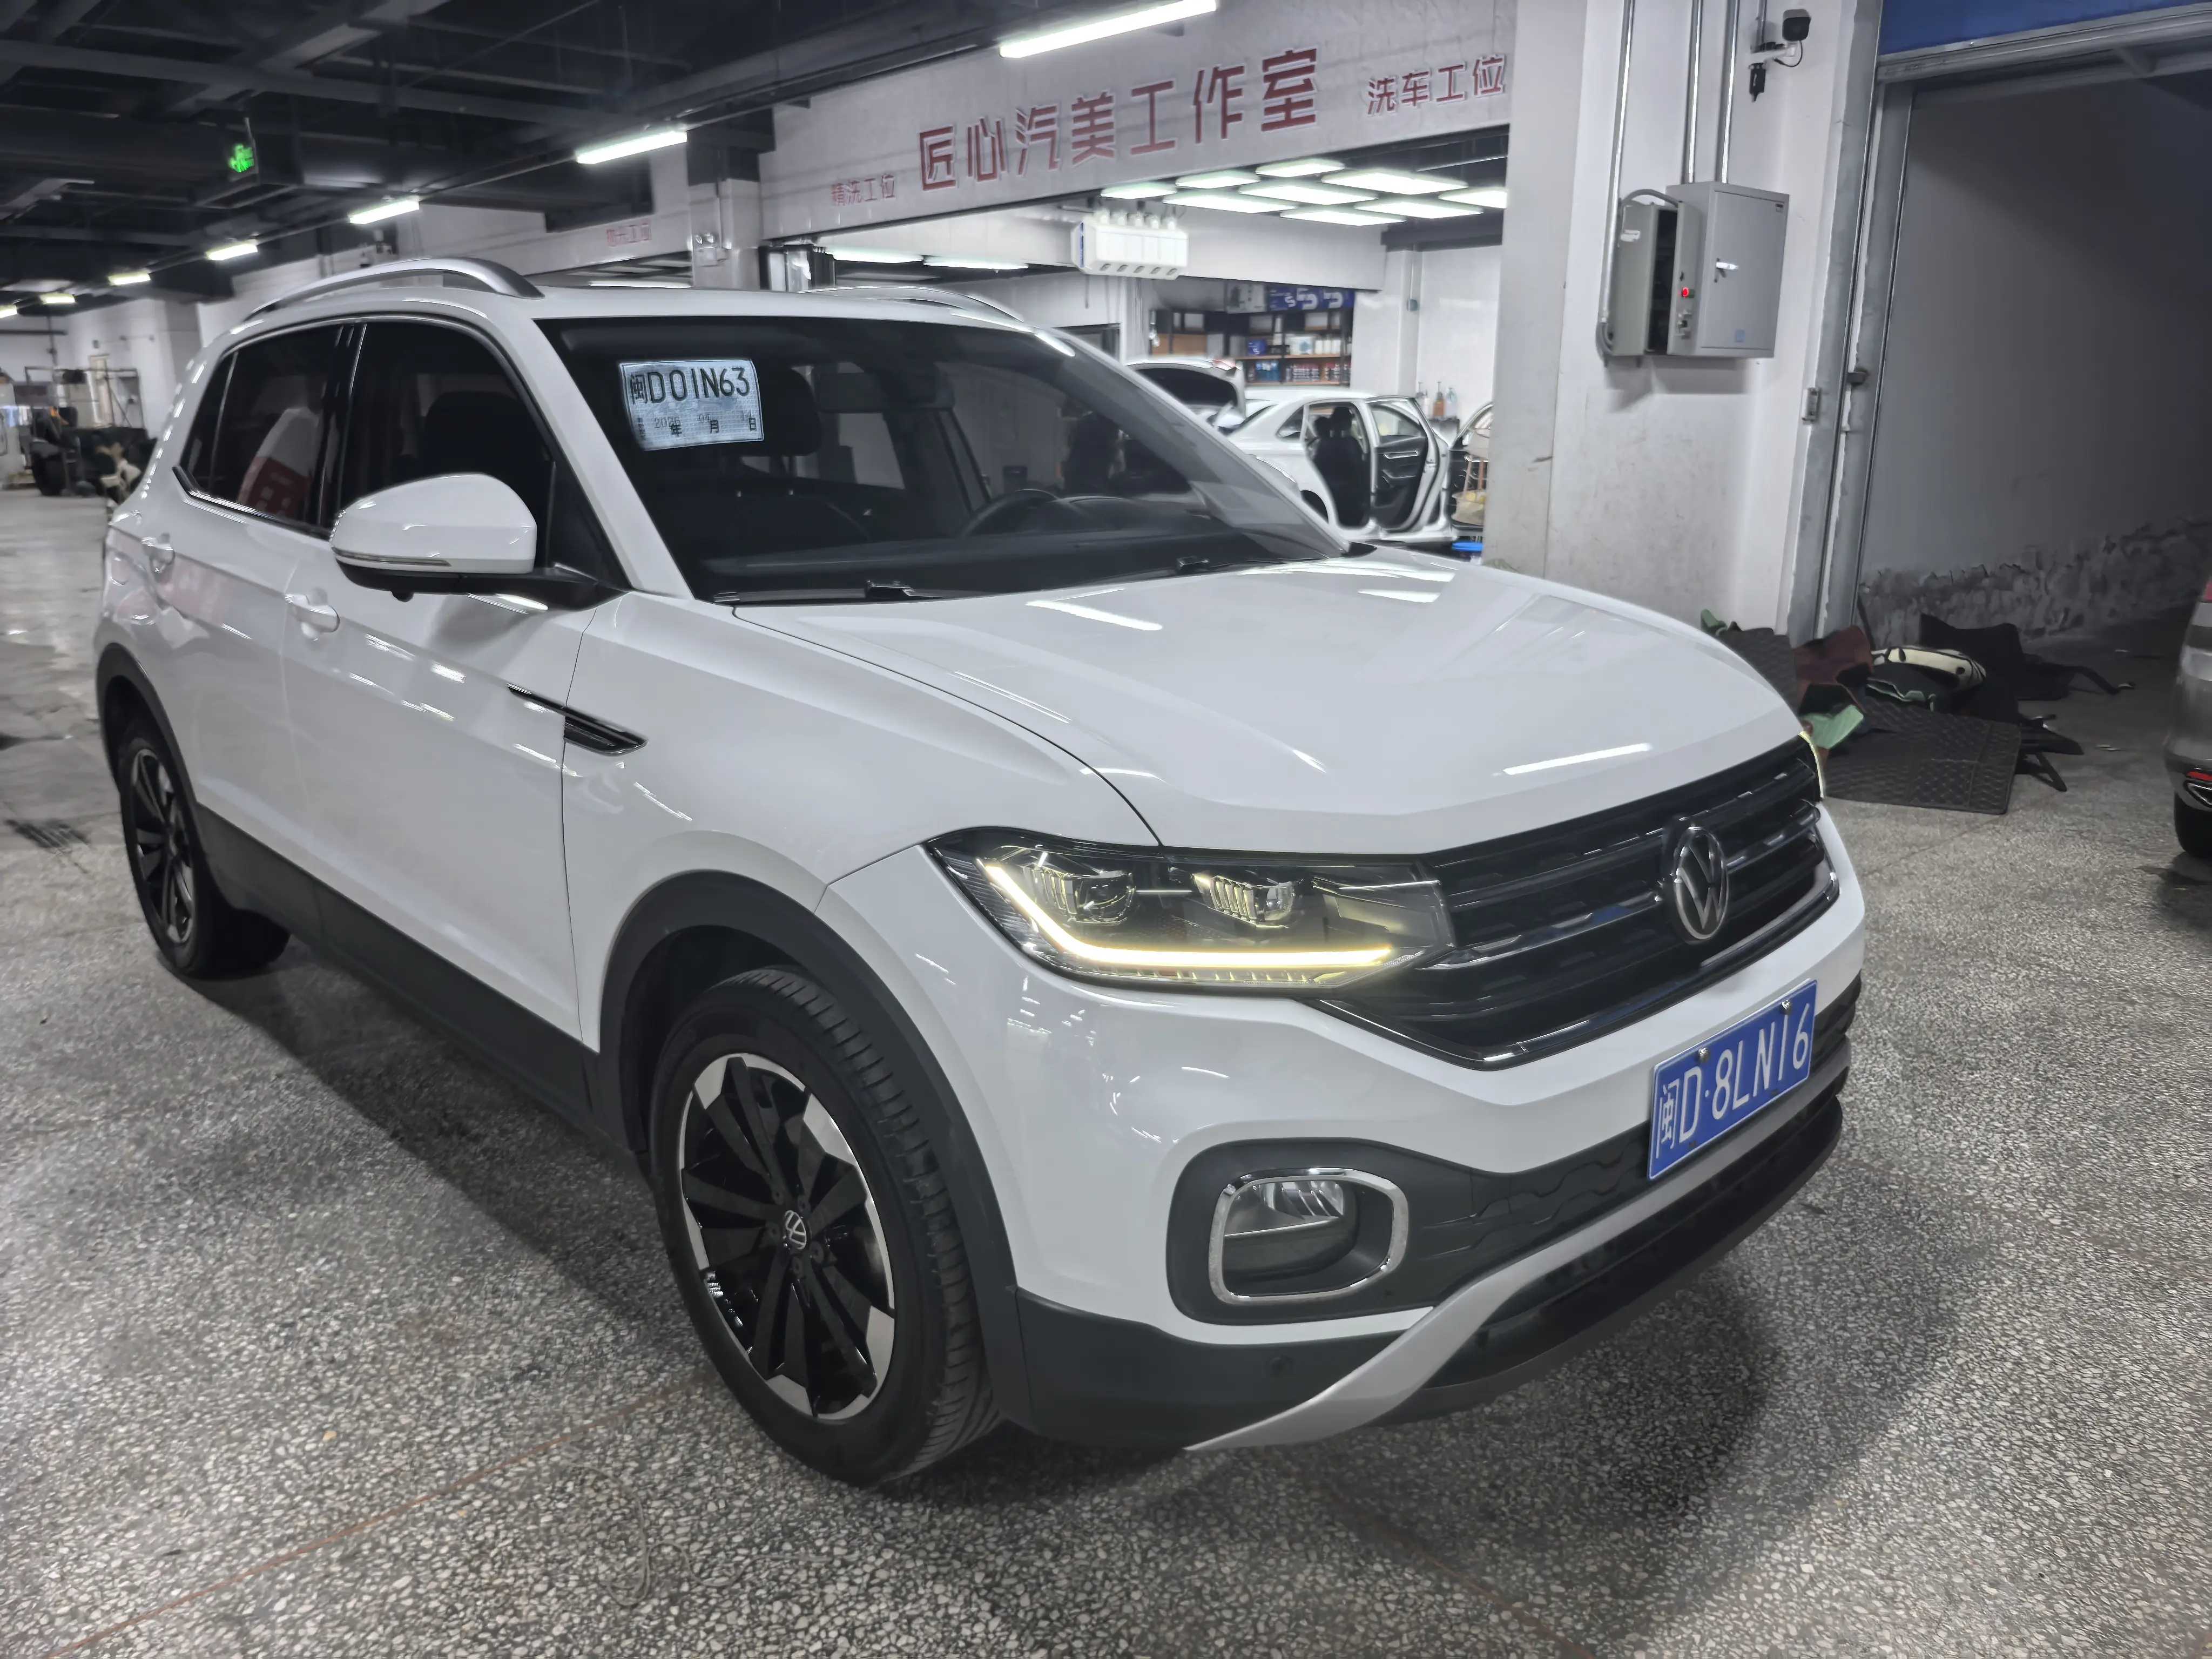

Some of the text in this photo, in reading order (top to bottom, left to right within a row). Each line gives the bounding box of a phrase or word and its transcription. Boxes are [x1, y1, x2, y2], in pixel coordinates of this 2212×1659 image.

[919, 48, 1318, 191] 匠心汽美工作室
[1367, 56, 1503, 114] 洗车工位
